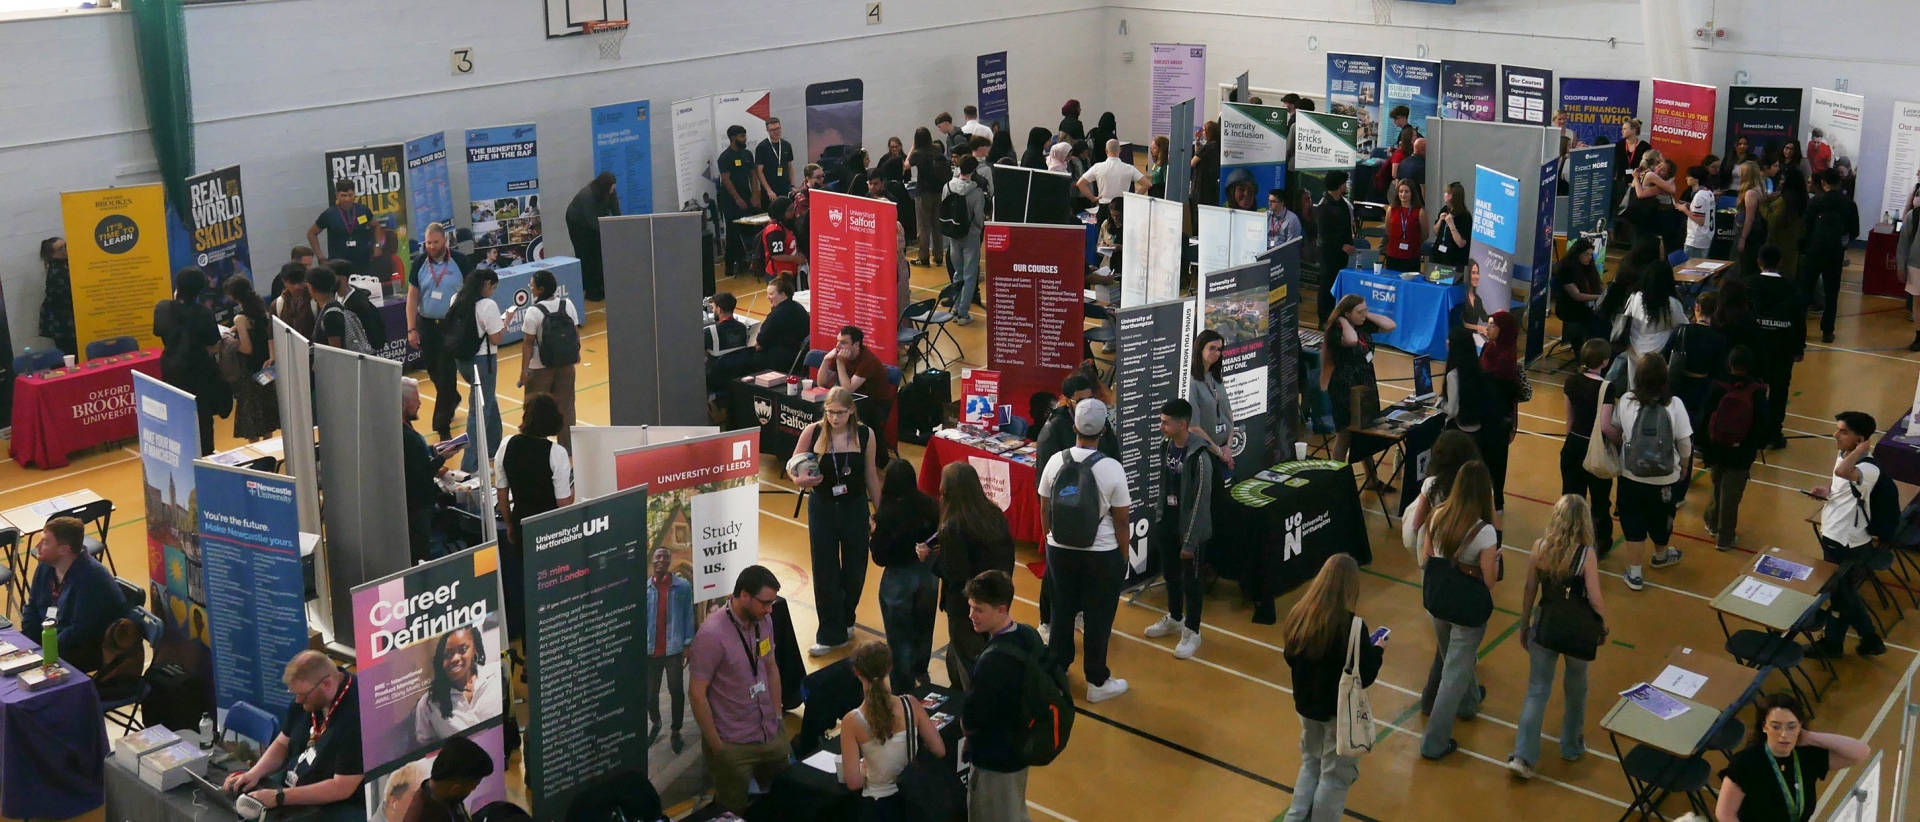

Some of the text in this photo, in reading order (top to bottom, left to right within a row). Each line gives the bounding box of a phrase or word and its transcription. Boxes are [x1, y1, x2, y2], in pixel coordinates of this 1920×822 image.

[868, 4, 880, 22] 4
[454, 50, 472, 73] 3
[981, 71, 996, 80] Discover
[982, 82, 1007, 94] expected
[1389, 84, 1420, 94] SUBJECT
[1461, 102, 1488, 113] Hope
[1584, 105, 1632, 114] FINANCIAL
[1816, 99, 1831, 107] Building
[1840, 103, 1860, 112] Engineers
[1671, 110, 1686, 118] CALL
[1224, 121, 1256, 131] Diversity
[1653, 114, 1708, 131] REBELS OF
[1231, 130, 1264, 140] Inclusion
[1298, 133, 1321, 144] Bricks
[1653, 125, 1707, 140] ACCOUNTANCY
[486, 144, 521, 154] BENEFITS
[1305, 143, 1332, 154] Mortar
[409, 158, 421, 167] FIND
[422, 154, 434, 163] YOUR
[434, 150, 445, 159] ROLE
[332, 153, 381, 179] REAL
[191, 178, 227, 207] REAL
[1505, 188, 1514, 197] RSM
[95, 198, 133, 208] BROOKES
[1476, 198, 1492, 211] MAKE
[192, 195, 242, 228] WORLD
[1475, 208, 1504, 225] AN IMPACT.
[106, 223, 122, 232] IT'S
[850, 217, 876, 228] Salford
[1482, 219, 1494, 229] OUR
[99, 231, 120, 241] TIME
[195, 217, 242, 251] SKILLS
[850, 226, 876, 234] MANCHESTER
[1473, 225, 1496, 238] FUTURE.
[104, 233, 133, 247] LEARN
[772, 241, 784, 253] 23
[1013, 263, 1058, 273] OUR COURSES
[1209, 279, 1228, 288] University
[1209, 283, 1236, 292] Northampton
[1372, 289, 1395, 303] RSM
[1121, 316, 1146, 325] University
[1121, 320, 1154, 330] Northampton
[1761, 319, 1792, 328] RELIGION
[384, 339, 407, 350] & CITY
[1222, 347, 1242, 357] OWER
[1222, 352, 1256, 365] MEANS MORE
[1223, 361, 1247, 372] DAY ONE.
[89, 384, 130, 400] OXFORD
[72, 392, 137, 419] BROOKE
[780, 404, 806, 420] University
[83, 406, 138, 425] UNIVERSITY
[657, 461, 751, 484] UNIVERSITY OF LEEDS
[257, 484, 292, 496] Newcastle
[257, 490, 292, 504] University
[203, 511, 270, 532] You're the future.
[1284, 512, 1302, 532] UO
[1302, 510, 1329, 530] University of
[536, 515, 609, 552] Hertfordshire UH
[536, 524, 580, 544] University of
[703, 521, 742, 540] Study
[1302, 518, 1331, 537] Northampton
[205, 522, 293, 548] Make Newcastle yours.
[703, 538, 738, 558] with
[1283, 526, 1302, 562] N
[537, 564, 570, 580] 25 mins
[703, 562, 725, 575] us.
[538, 567, 590, 591] from London
[369, 580, 459, 627] Career
[539, 611, 570, 626] Accounting
[582, 600, 603, 610] Finance
[370, 598, 487, 659] Defining
